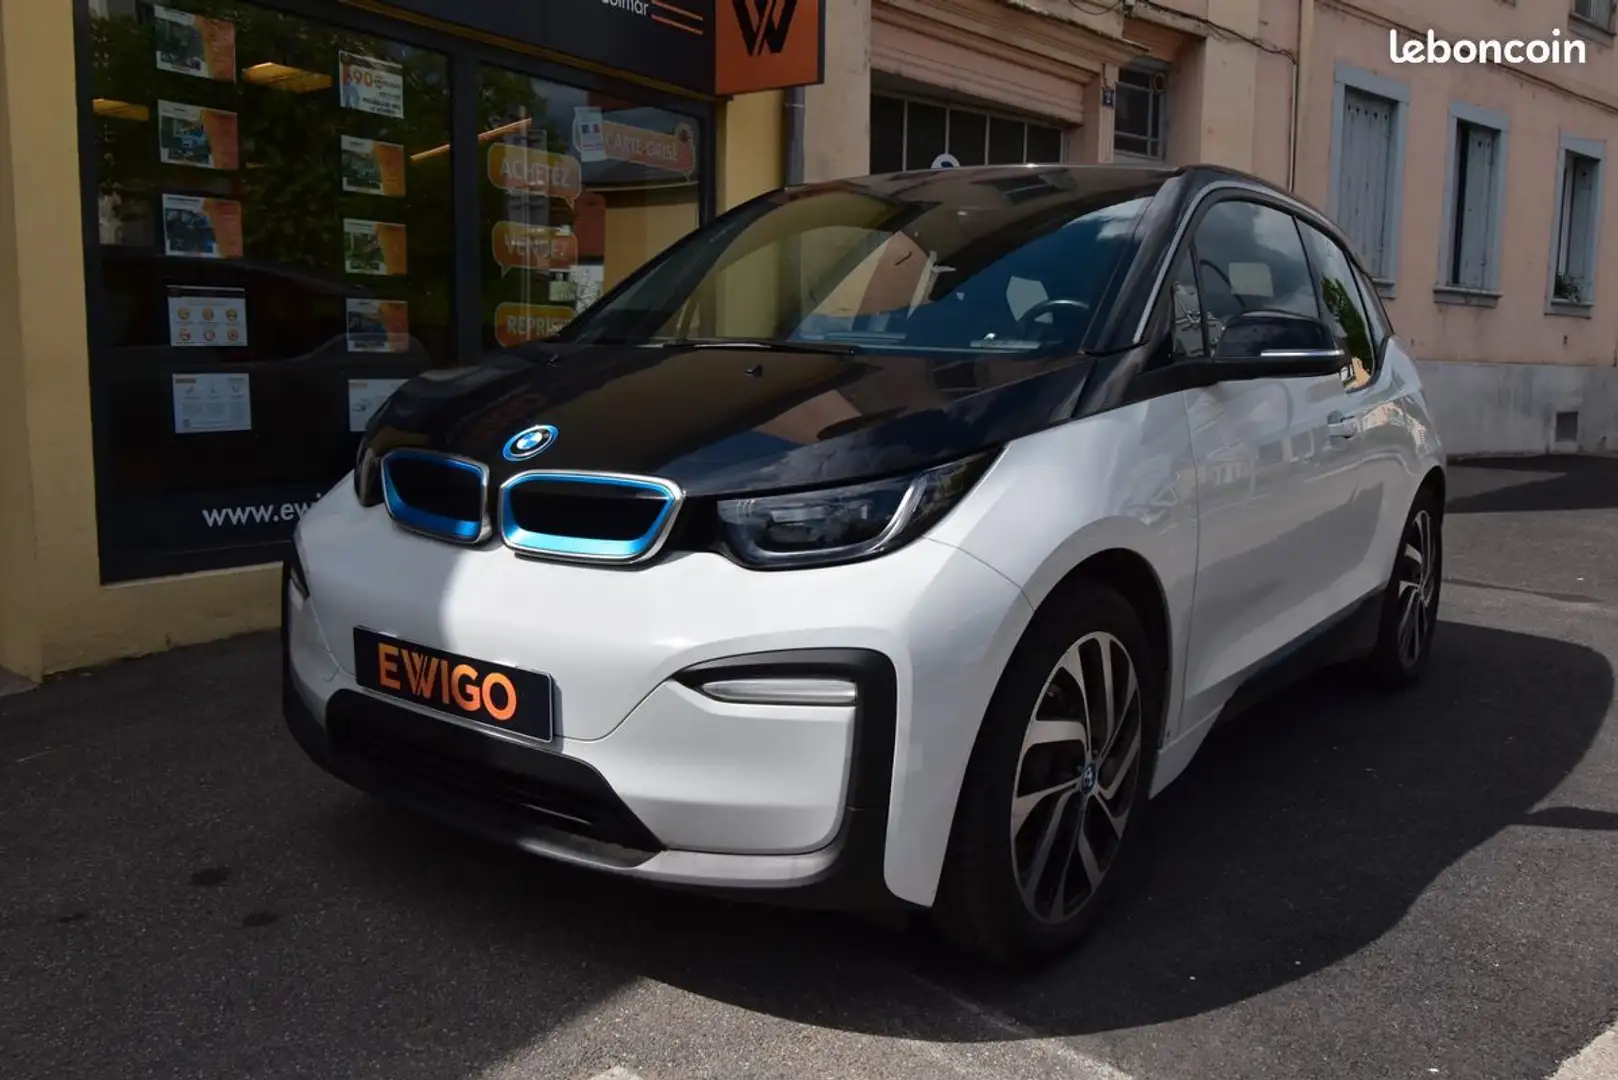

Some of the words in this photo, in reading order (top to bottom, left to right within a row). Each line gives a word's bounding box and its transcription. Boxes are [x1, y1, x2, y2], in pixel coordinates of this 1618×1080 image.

[499, 160, 571, 188] ACHETEZ
[504, 231, 567, 260] VENDEZ
[378, 642, 517, 721] EWIGO
